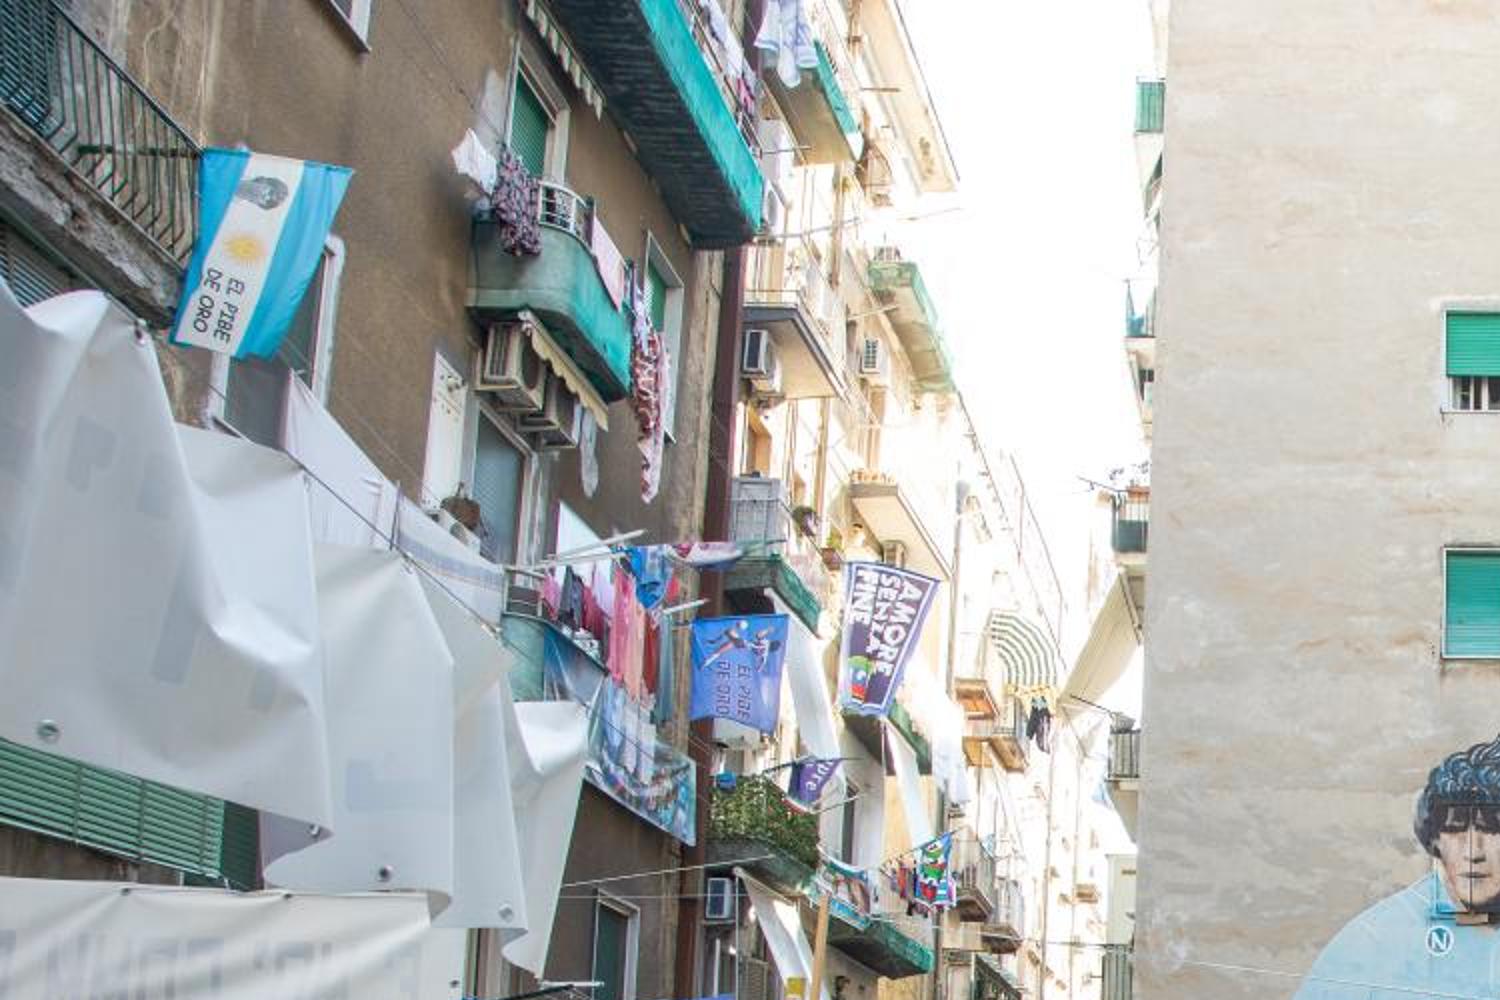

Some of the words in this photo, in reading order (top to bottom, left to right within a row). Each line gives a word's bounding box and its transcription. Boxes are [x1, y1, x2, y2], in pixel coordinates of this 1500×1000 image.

[203, 268, 222, 293] DE
[226, 278, 245, 295] EL
[194, 295, 215, 333] ORO
[213, 301, 238, 344] PIBE
[850, 569, 879, 625] FINE
[866, 574, 901, 654] SENZA
[876, 581, 923, 677] AMORE
[717, 661, 731, 678] DE
[737, 664, 751, 679] EL
[737, 686, 752, 722] PIBE
